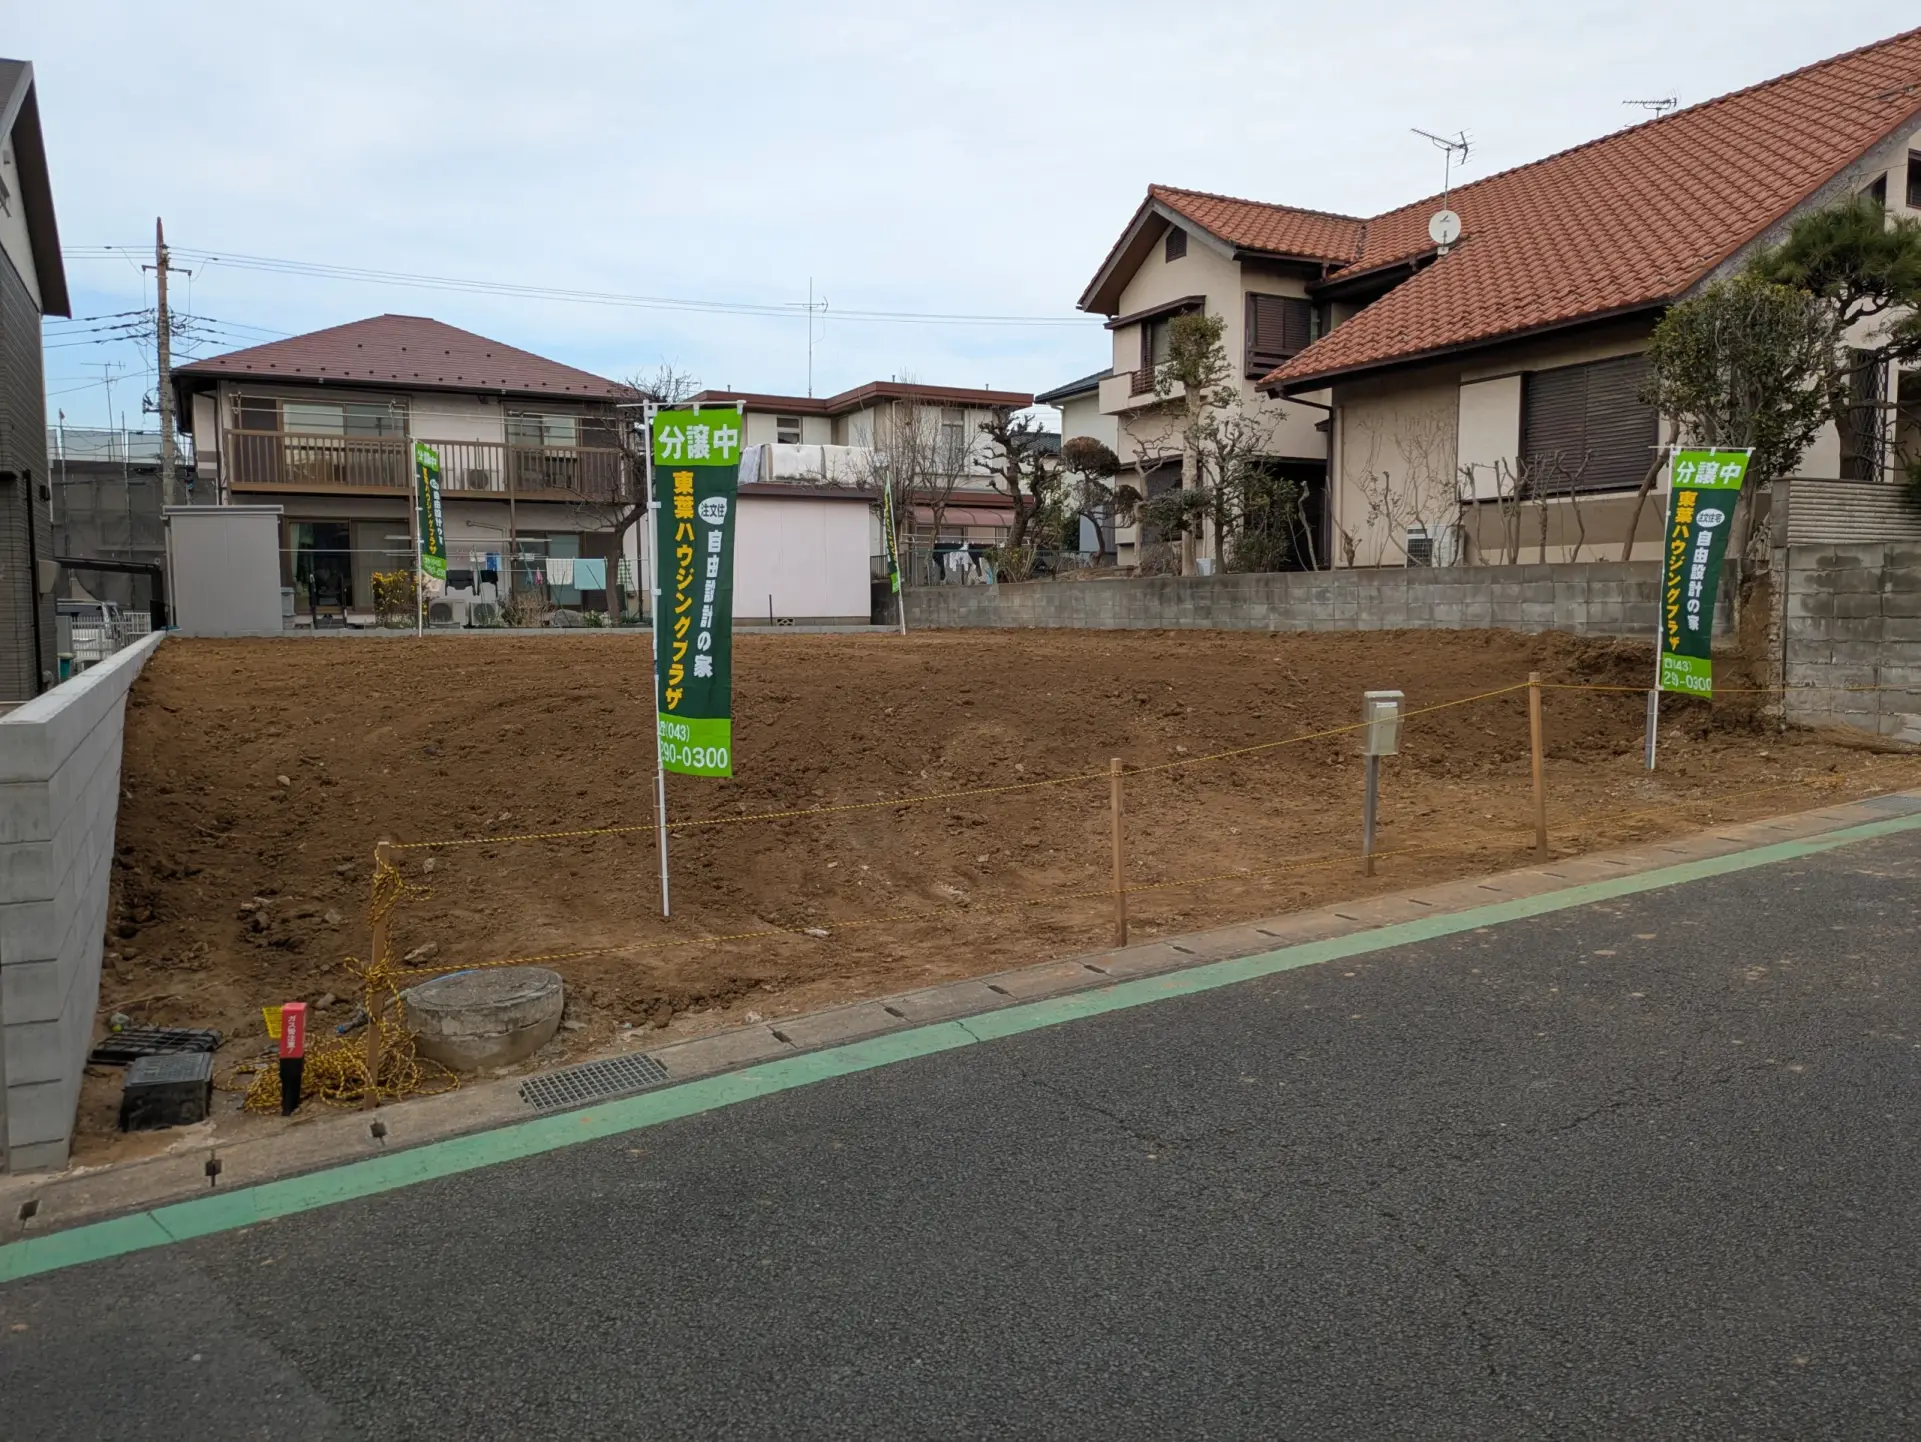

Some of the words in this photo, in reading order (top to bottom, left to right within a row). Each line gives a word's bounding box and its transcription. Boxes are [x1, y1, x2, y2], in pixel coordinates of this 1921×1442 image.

[658, 423, 738, 460] 分譲中
[1676, 460, 1742, 485] 分譲中
[693, 529, 723, 678] 自由設計の家
[1686, 530, 1713, 631] 自由設計の家
